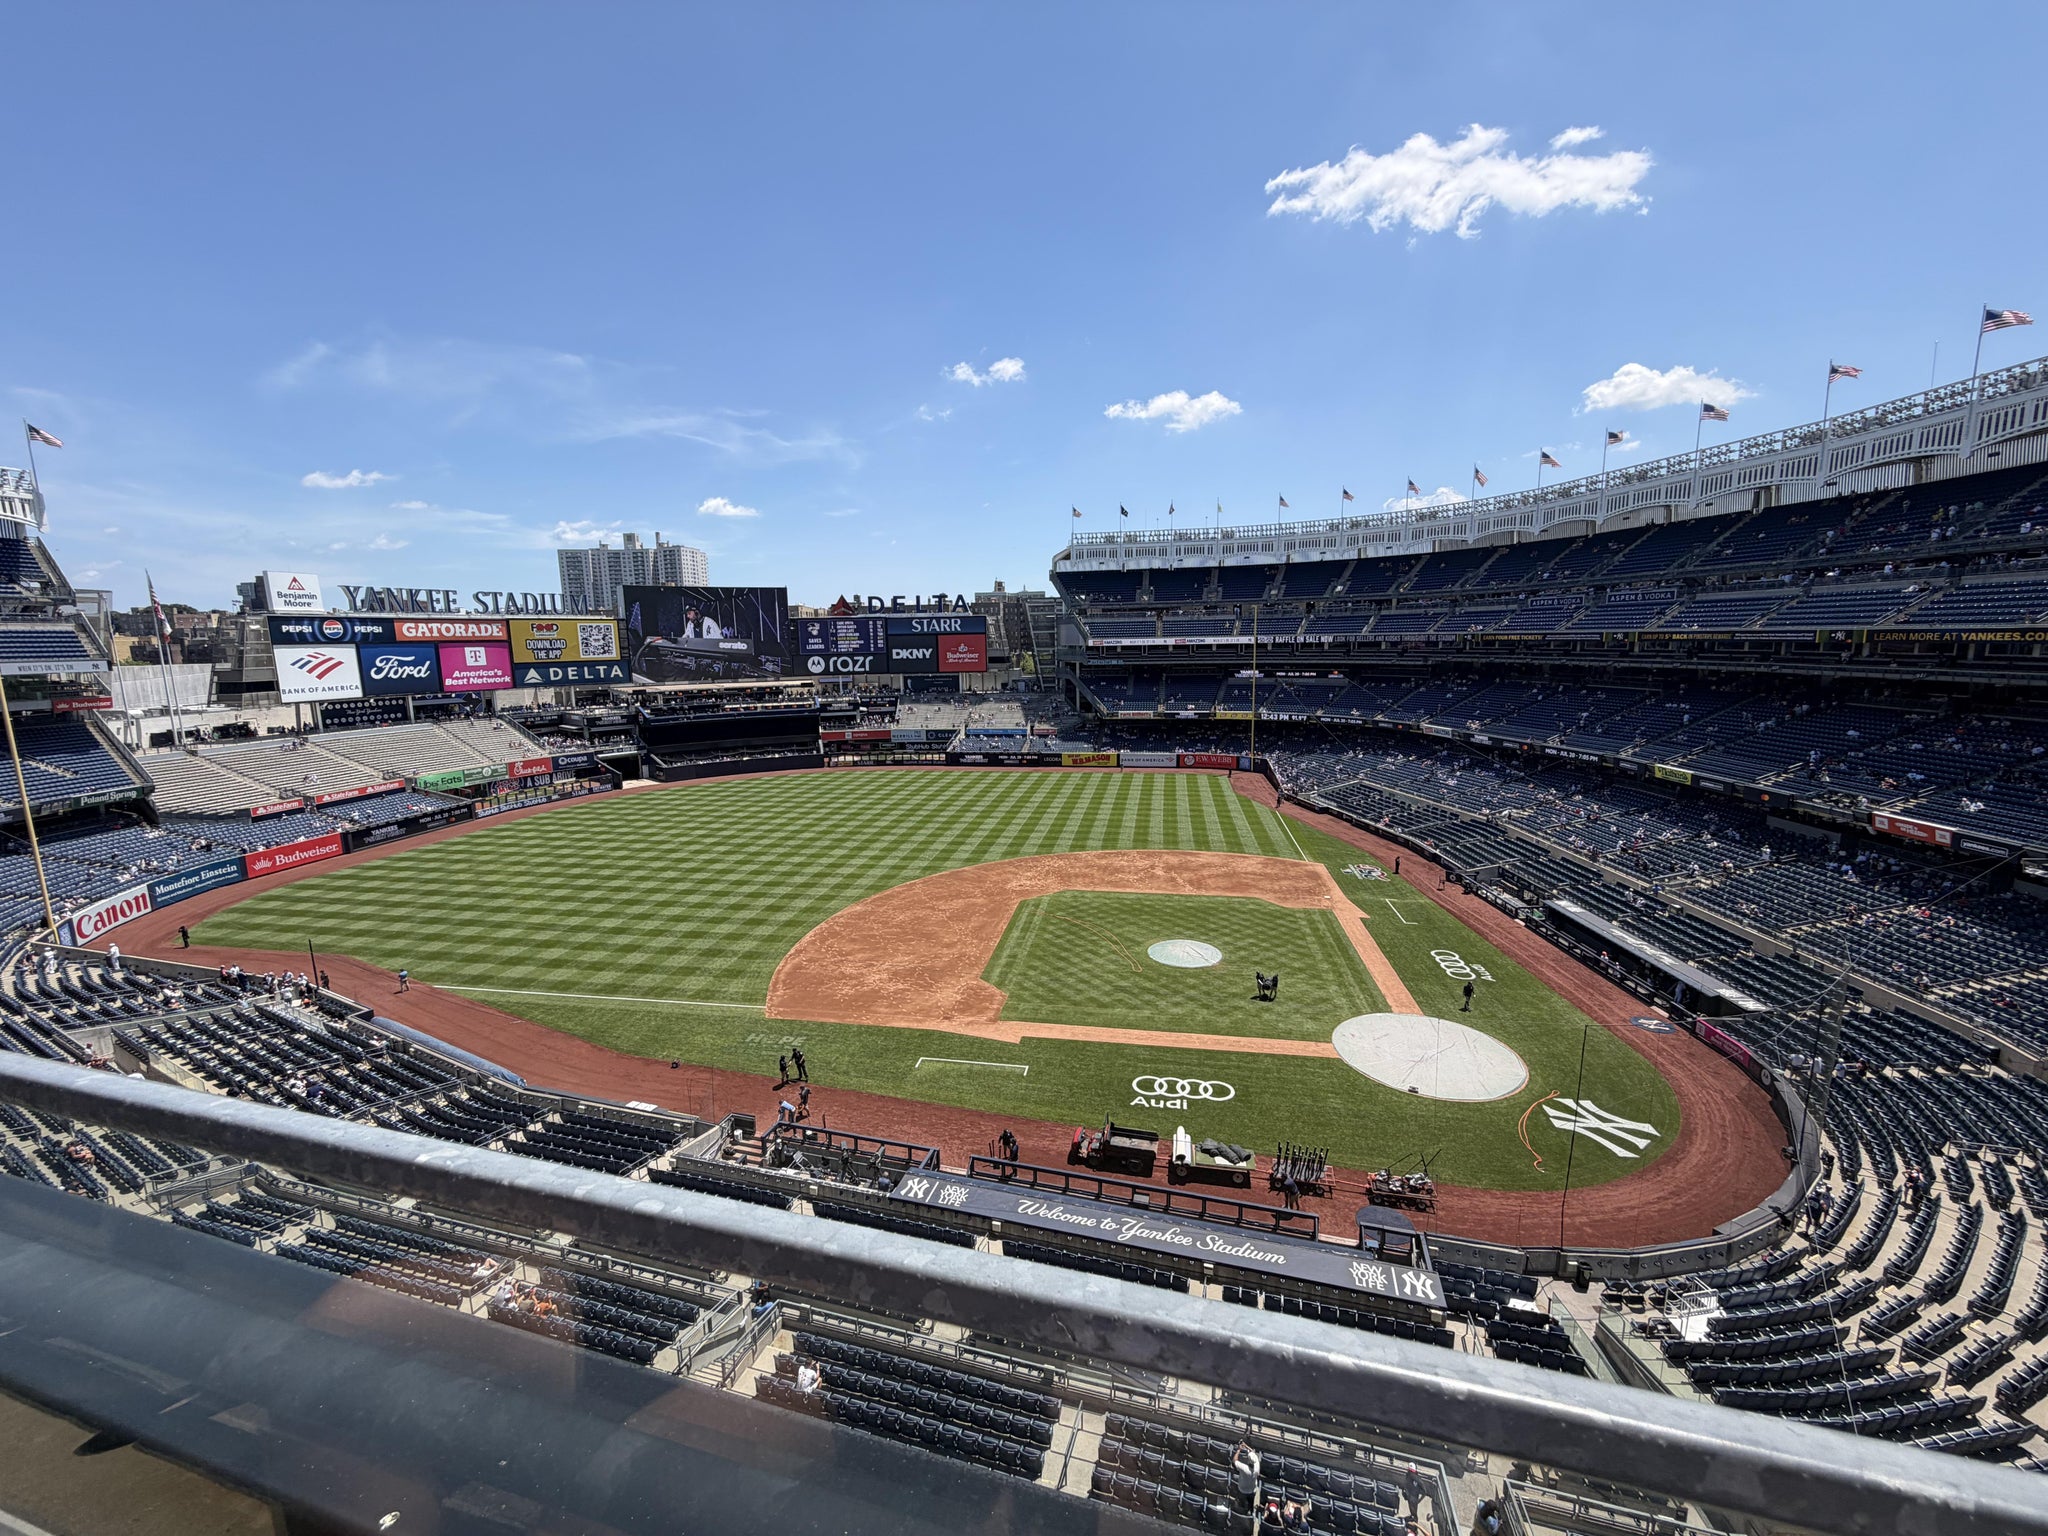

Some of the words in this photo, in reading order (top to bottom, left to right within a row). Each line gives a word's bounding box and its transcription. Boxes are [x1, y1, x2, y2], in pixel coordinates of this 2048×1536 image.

[277, 591, 317, 600] Benjamin
[337, 585, 459, 613] YANKEE
[473, 591, 589, 614] STADIUM
[868, 594, 970, 614] DELTA
[282, 625, 312, 633] PEPSI
[354, 625, 382, 633] PEPSI
[402, 622, 502, 637] GATORADE
[912, 619, 961, 632] STARR
[1908, 632, 1940, 640] MORE
[1943, 632, 1957, 640] AT
[527, 639, 566, 649] DOWNLOAD
[719, 641, 748, 650] serato
[534, 649, 547, 659] THE
[548, 649, 562, 659] APP
[892, 648, 933, 659] DKNY
[946, 652, 979, 660] Budweiser
[370, 655, 430, 680] Ford
[830, 656, 873, 672] razr
[452, 669, 502, 678] America's
[470, 675, 511, 684] Network
[550, 665, 623, 681] DELTA
[322, 684, 360, 692] AMERICA
[567, 755, 587, 765] coupa
[1211, 755, 1232, 763] WEBB
[441, 775, 462, 785] Eats
[527, 779, 532, 788] A
[535, 776, 550, 786] SUB
[552, 770, 575, 782] ABOVE
[80, 793, 109, 806] Poland
[110, 790, 137, 801] Spring
[478, 808, 499, 818] StubHub
[500, 802, 522, 812] StubHub
[524, 798, 547, 807] StubHub
[371, 825, 398, 836] YANKEES
[274, 842, 339, 866] Budweiser
[1963, 841, 2005, 855] yankees.com
[155, 875, 200, 896] Montefiore
[201, 864, 237, 881] Einstein
[76, 892, 149, 940] Canon
[1130, 1096, 1187, 1110] Audi
[940, 1189, 968, 1202] YORK
[944, 1184, 969, 1196] NEW
[938, 1196, 962, 1208] LIFE
[1017, 1200, 1096, 1228] Welcome
[1100, 1217, 1119, 1230] to
[1117, 1218, 1192, 1246] Yankee
[1196, 1234, 1286, 1265] Stadium
[1353, 1261, 1382, 1276] NEW
[1349, 1267, 1388, 1285] YORK
[1353, 1273, 1385, 1291] LIFE
